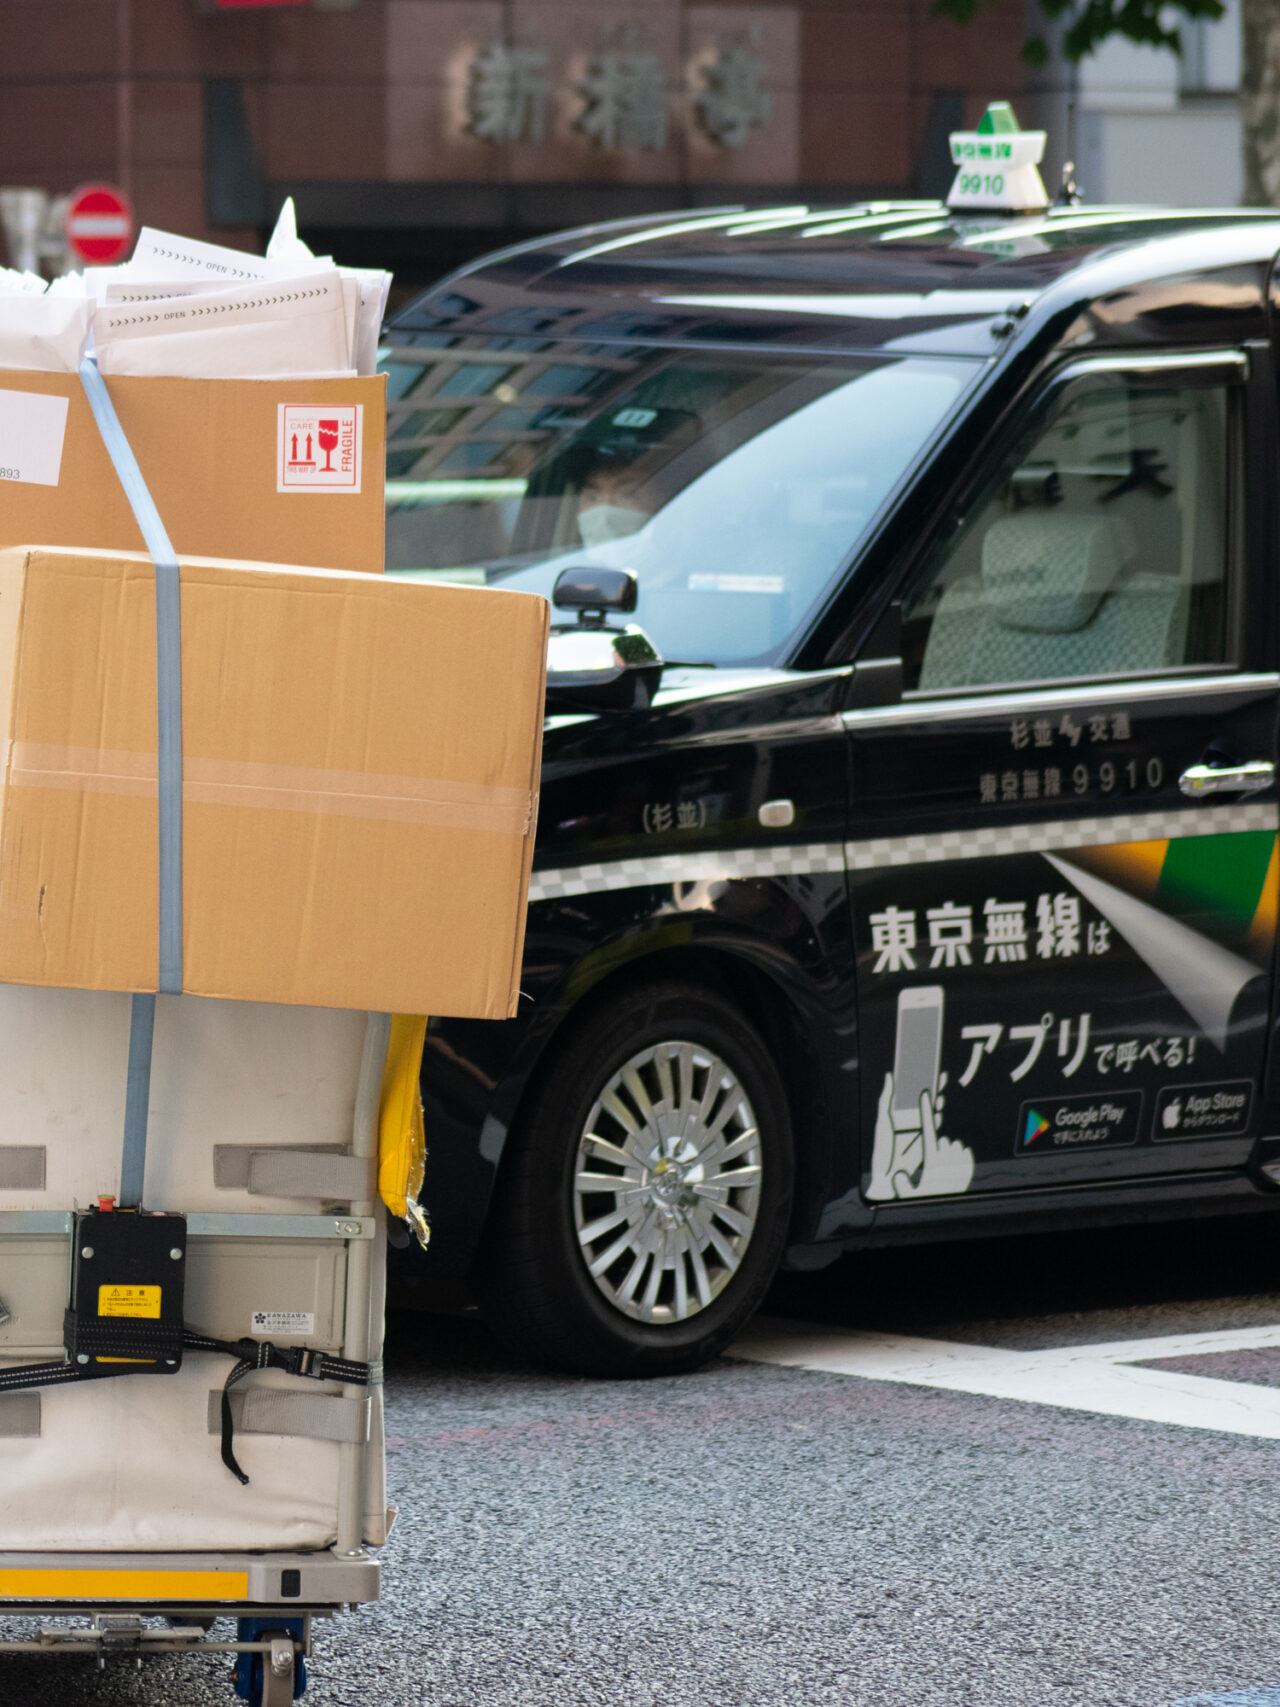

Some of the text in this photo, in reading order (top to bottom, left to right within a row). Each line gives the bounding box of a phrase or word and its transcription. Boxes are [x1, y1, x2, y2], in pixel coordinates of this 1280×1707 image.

[960, 174, 1005, 195] 9910
[205, 261, 228, 273] OPEN
[163, 310, 186, 320] OPEN
[341, 419, 353, 472] FRAGILE
[1072, 757, 1163, 795] 9910
[869, 892, 1111, 973] 東京無線は
[1055, 1102, 1127, 1127] Google Play
[1184, 1091, 1246, 1114] App Store
